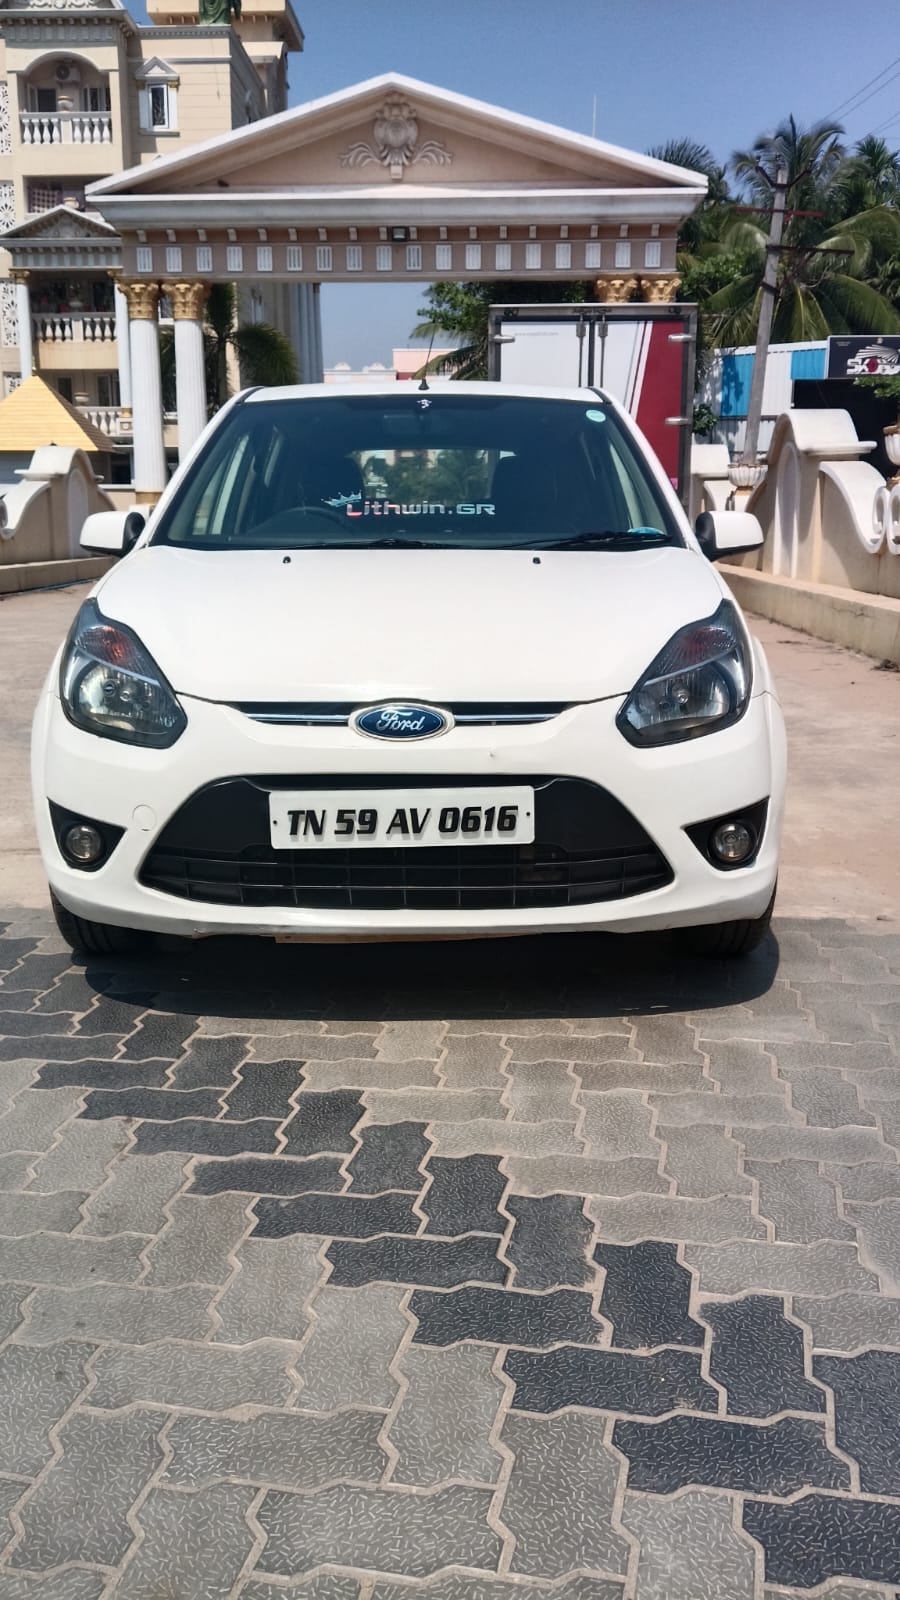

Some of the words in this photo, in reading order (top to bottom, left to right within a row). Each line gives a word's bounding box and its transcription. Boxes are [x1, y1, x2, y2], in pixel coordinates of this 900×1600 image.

[346, 501, 496, 516] Lithwin.GR
[376, 706, 427, 732] Ford
[287, 809, 327, 836] TN
[334, 808, 378, 835] 59
[386, 807, 431, 834] AV
[438, 805, 519, 833] 0616
